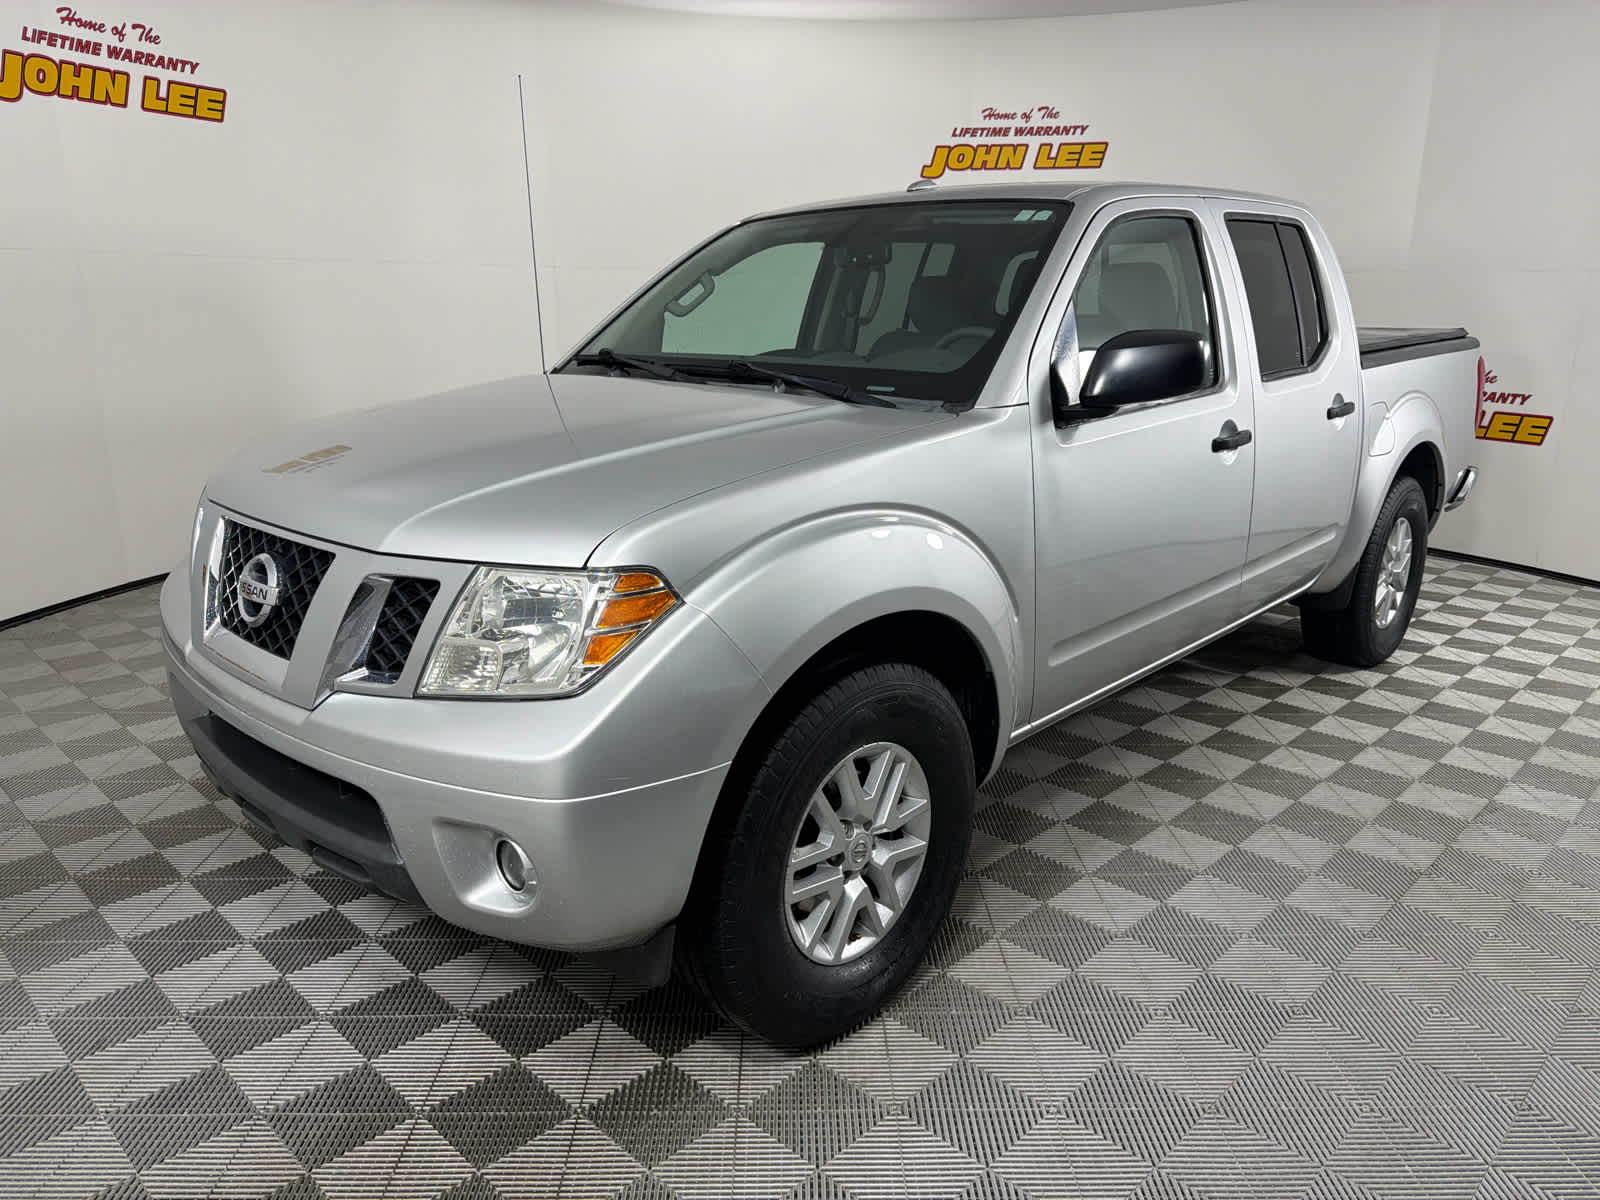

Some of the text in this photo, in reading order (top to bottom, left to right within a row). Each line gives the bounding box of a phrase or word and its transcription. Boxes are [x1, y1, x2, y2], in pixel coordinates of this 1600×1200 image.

[56, 7, 161, 45] Home of The
[21, 26, 200, 74] LIFETIME WARRANTY
[0, 49, 227, 123] JOHN LEE
[951, 125, 1089, 138] LIFETIME WARRANTY
[981, 106, 1060, 124] Home of The
[920, 141, 1109, 179] JOHN LEE
